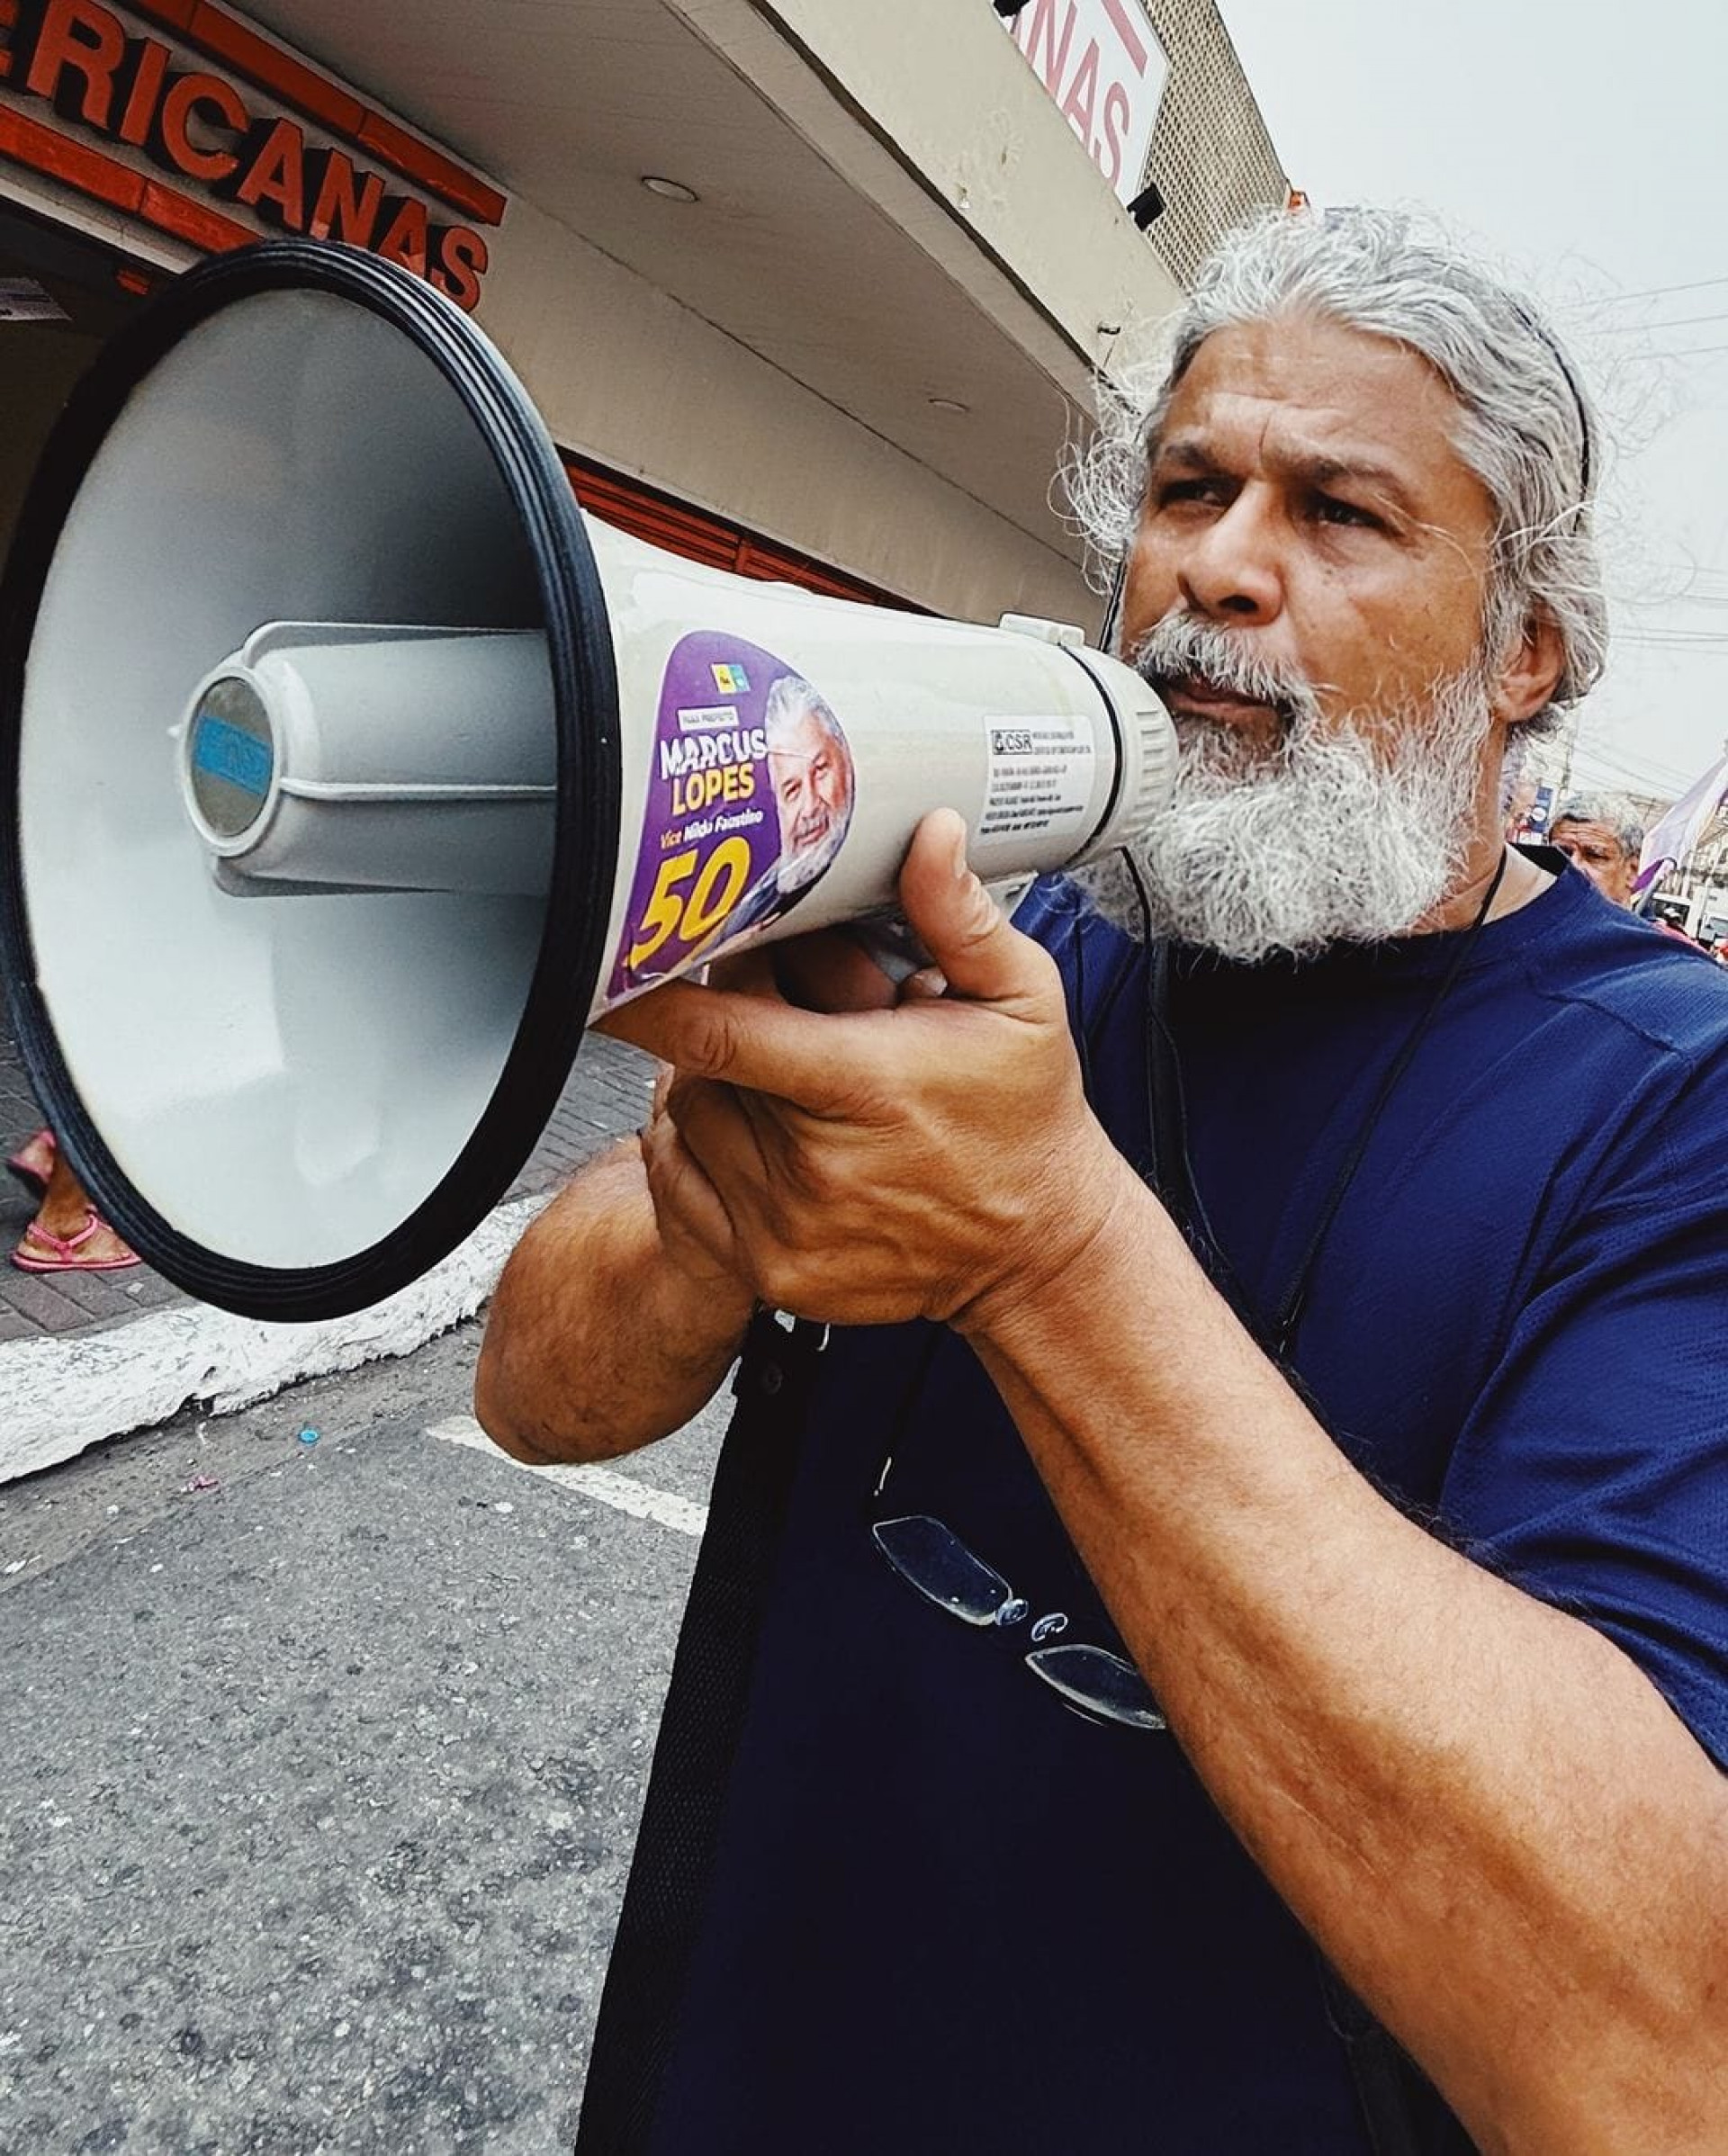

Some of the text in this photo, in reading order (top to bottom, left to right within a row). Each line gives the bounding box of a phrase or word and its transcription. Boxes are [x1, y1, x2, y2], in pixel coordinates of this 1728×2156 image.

[1010, 0, 1130, 188] NAS
[660, 728, 768, 780] MARCUS
[1004, 733, 1033, 750] CSR
[672, 762, 754, 815] LOPES
[629, 835, 751, 971] 50
